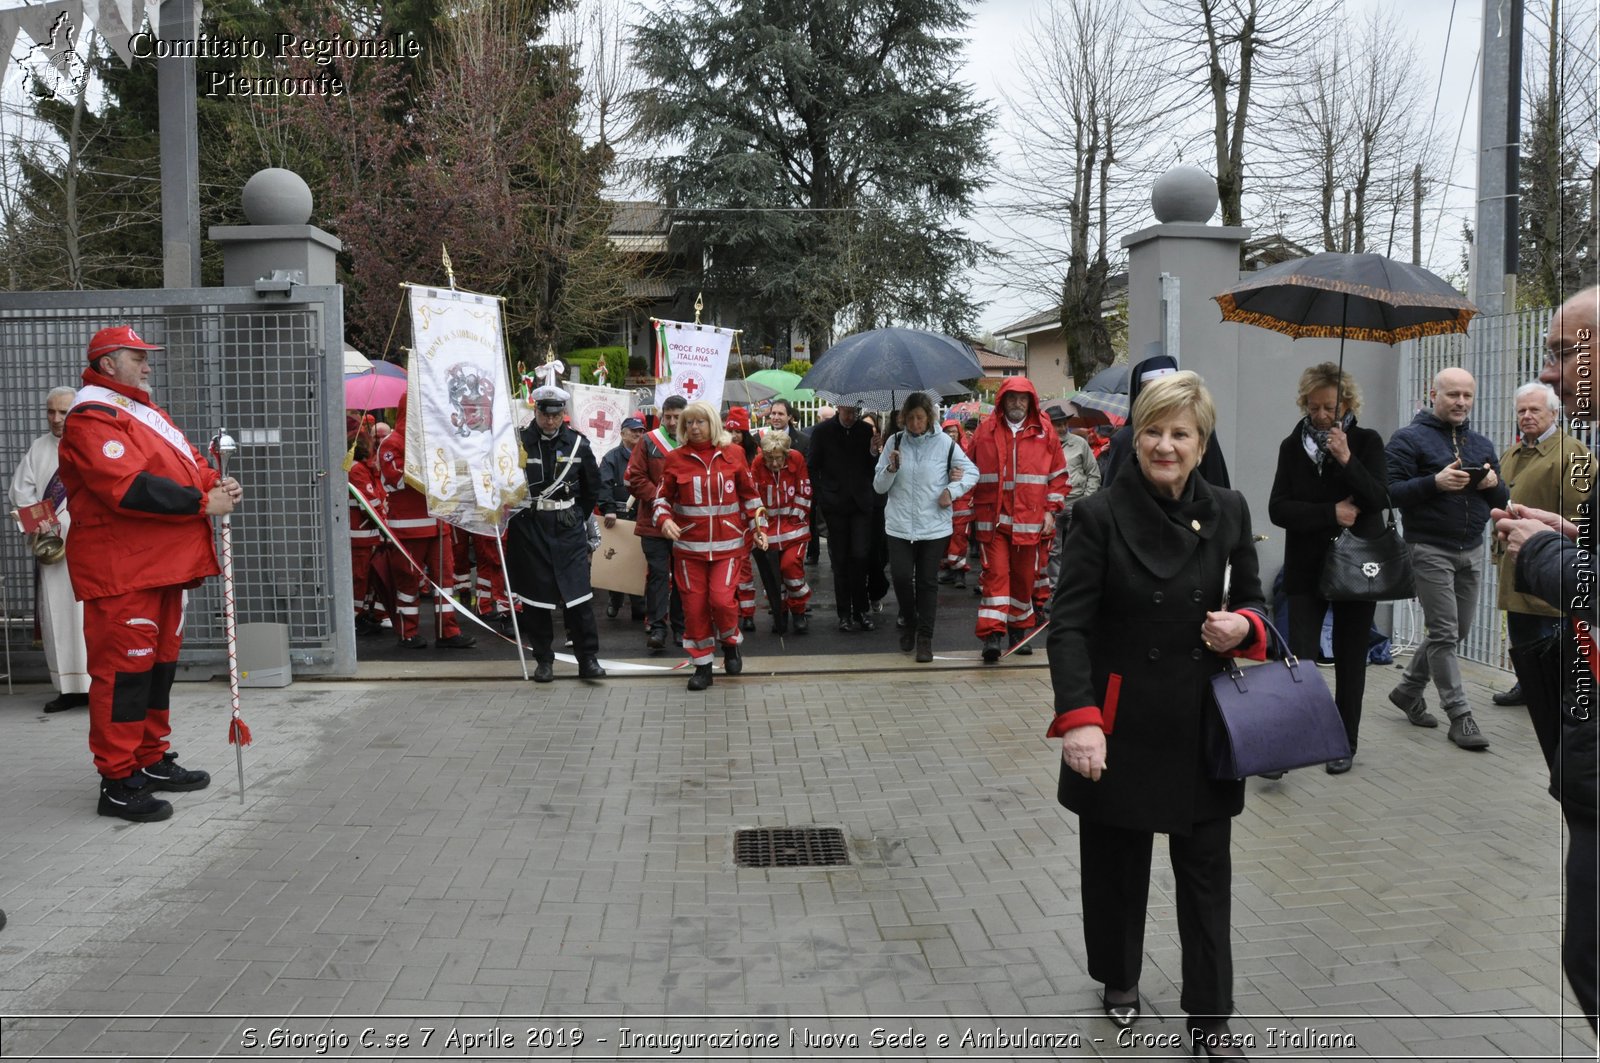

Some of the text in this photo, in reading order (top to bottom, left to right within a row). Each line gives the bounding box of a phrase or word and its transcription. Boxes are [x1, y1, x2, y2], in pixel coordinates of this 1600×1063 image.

[669, 343, 719, 356] CROCE ROSSA
[677, 353, 709, 362] ITALIANA
[146, 411, 180, 444] CROCE
